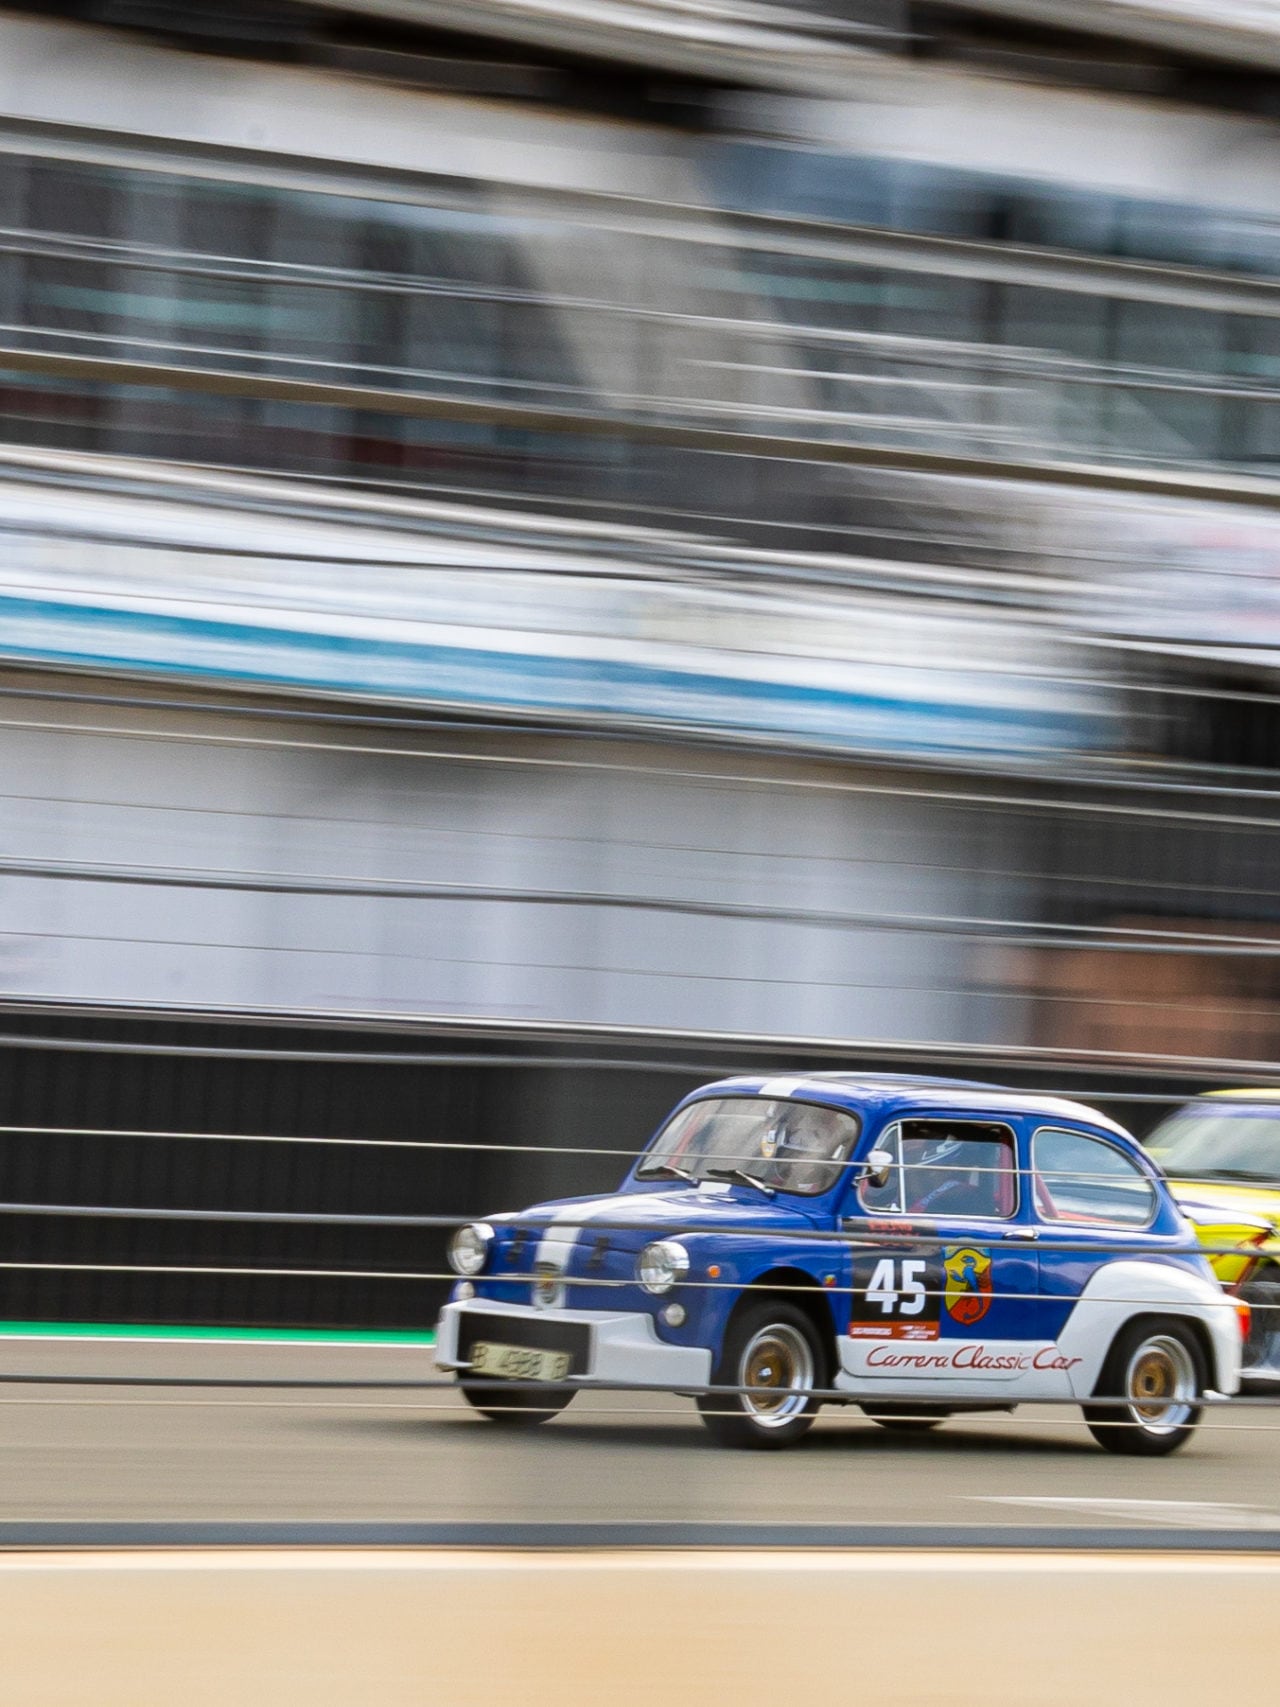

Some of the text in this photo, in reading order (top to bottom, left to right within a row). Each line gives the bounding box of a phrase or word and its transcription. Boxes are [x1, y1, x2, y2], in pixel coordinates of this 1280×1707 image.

[864, 1259, 927, 1315] 45
[866, 1345, 1084, 1370] Carrera Classic Car
